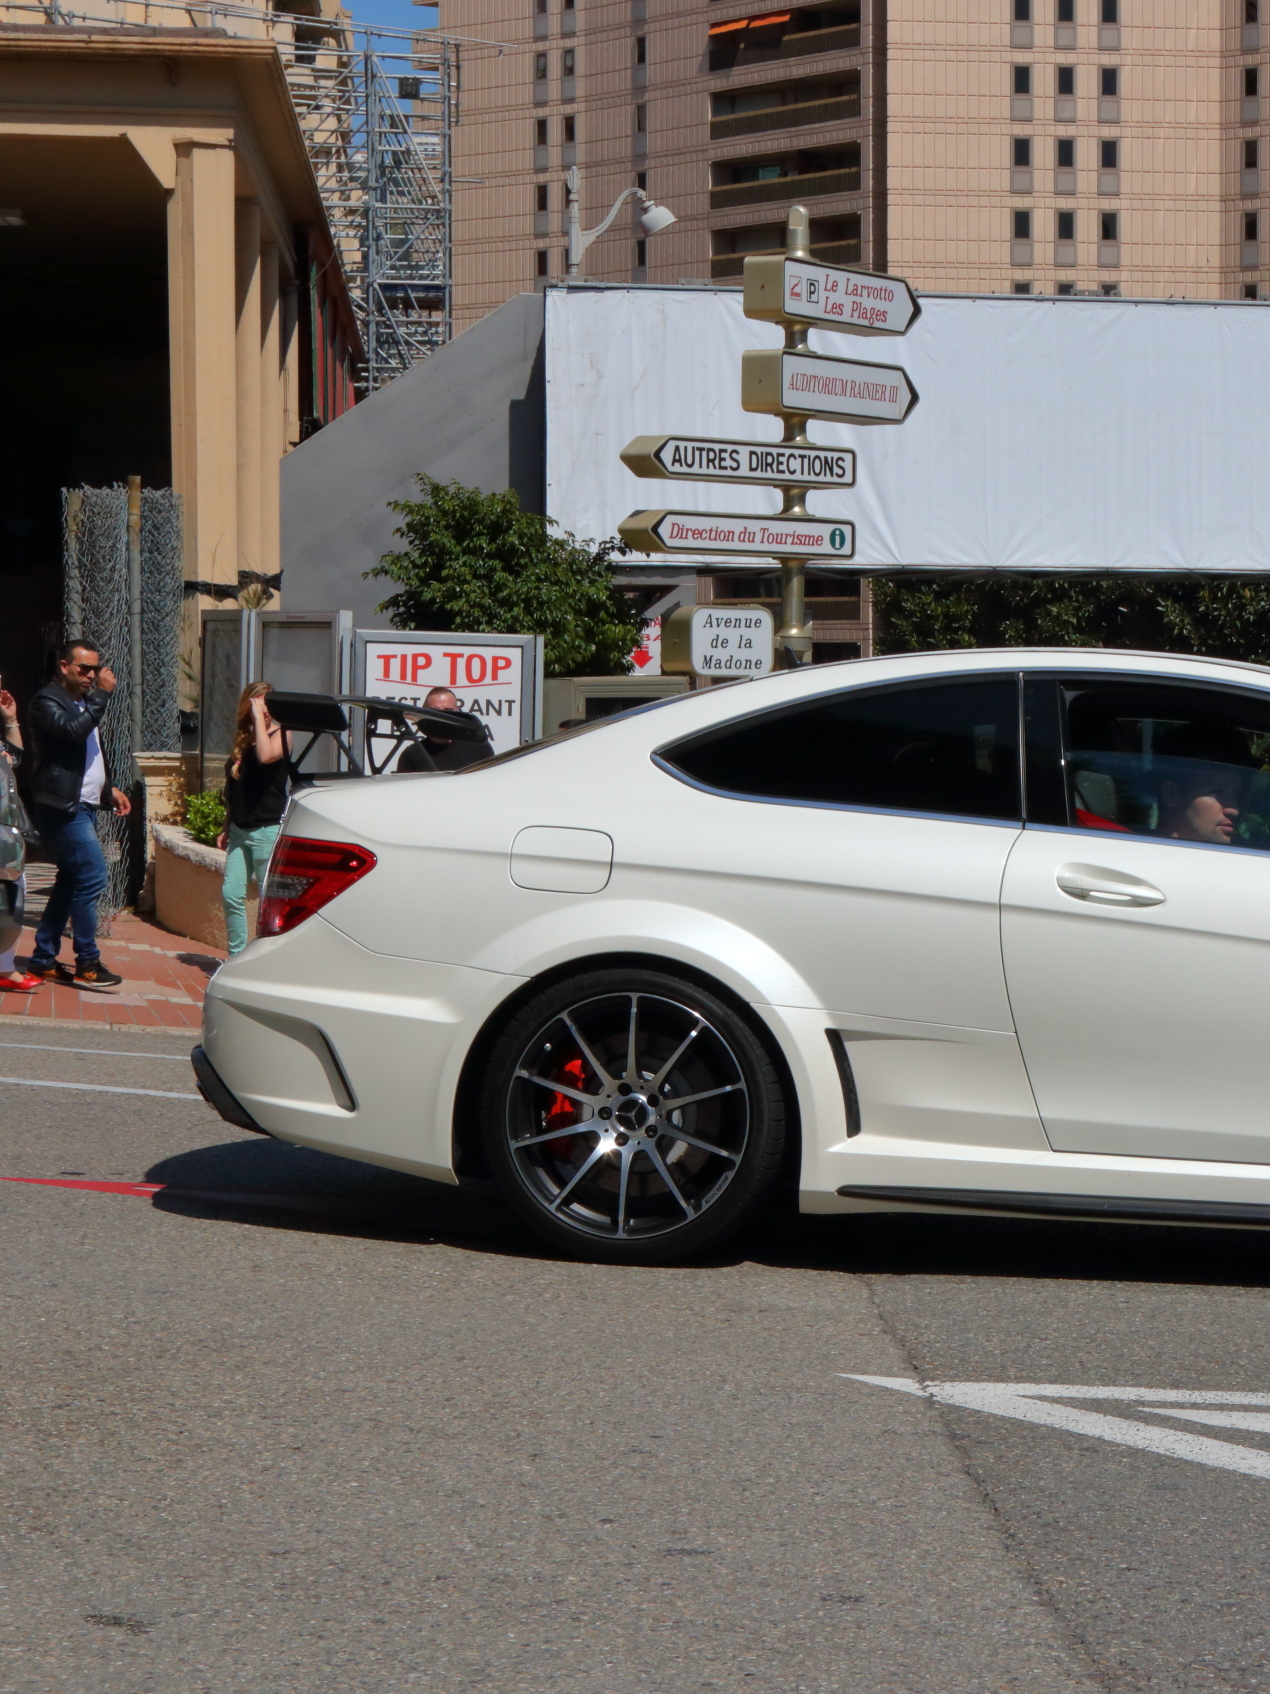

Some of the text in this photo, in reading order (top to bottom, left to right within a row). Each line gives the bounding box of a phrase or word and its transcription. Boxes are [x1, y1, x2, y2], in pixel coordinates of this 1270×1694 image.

[823, 274, 895, 303] Le Larvotto
[823, 296, 889, 326] Les Plages
[787, 372, 899, 403] AUDITORIUM RAINIER III
[671, 444, 846, 479] AUTRES DIRECTIONS
[668, 522, 824, 547] Direction du Tourisme
[702, 613, 762, 629] Avenue
[710, 634, 753, 649] de la
[376, 652, 513, 686] TIP TOP
[701, 654, 763, 670] Madone
